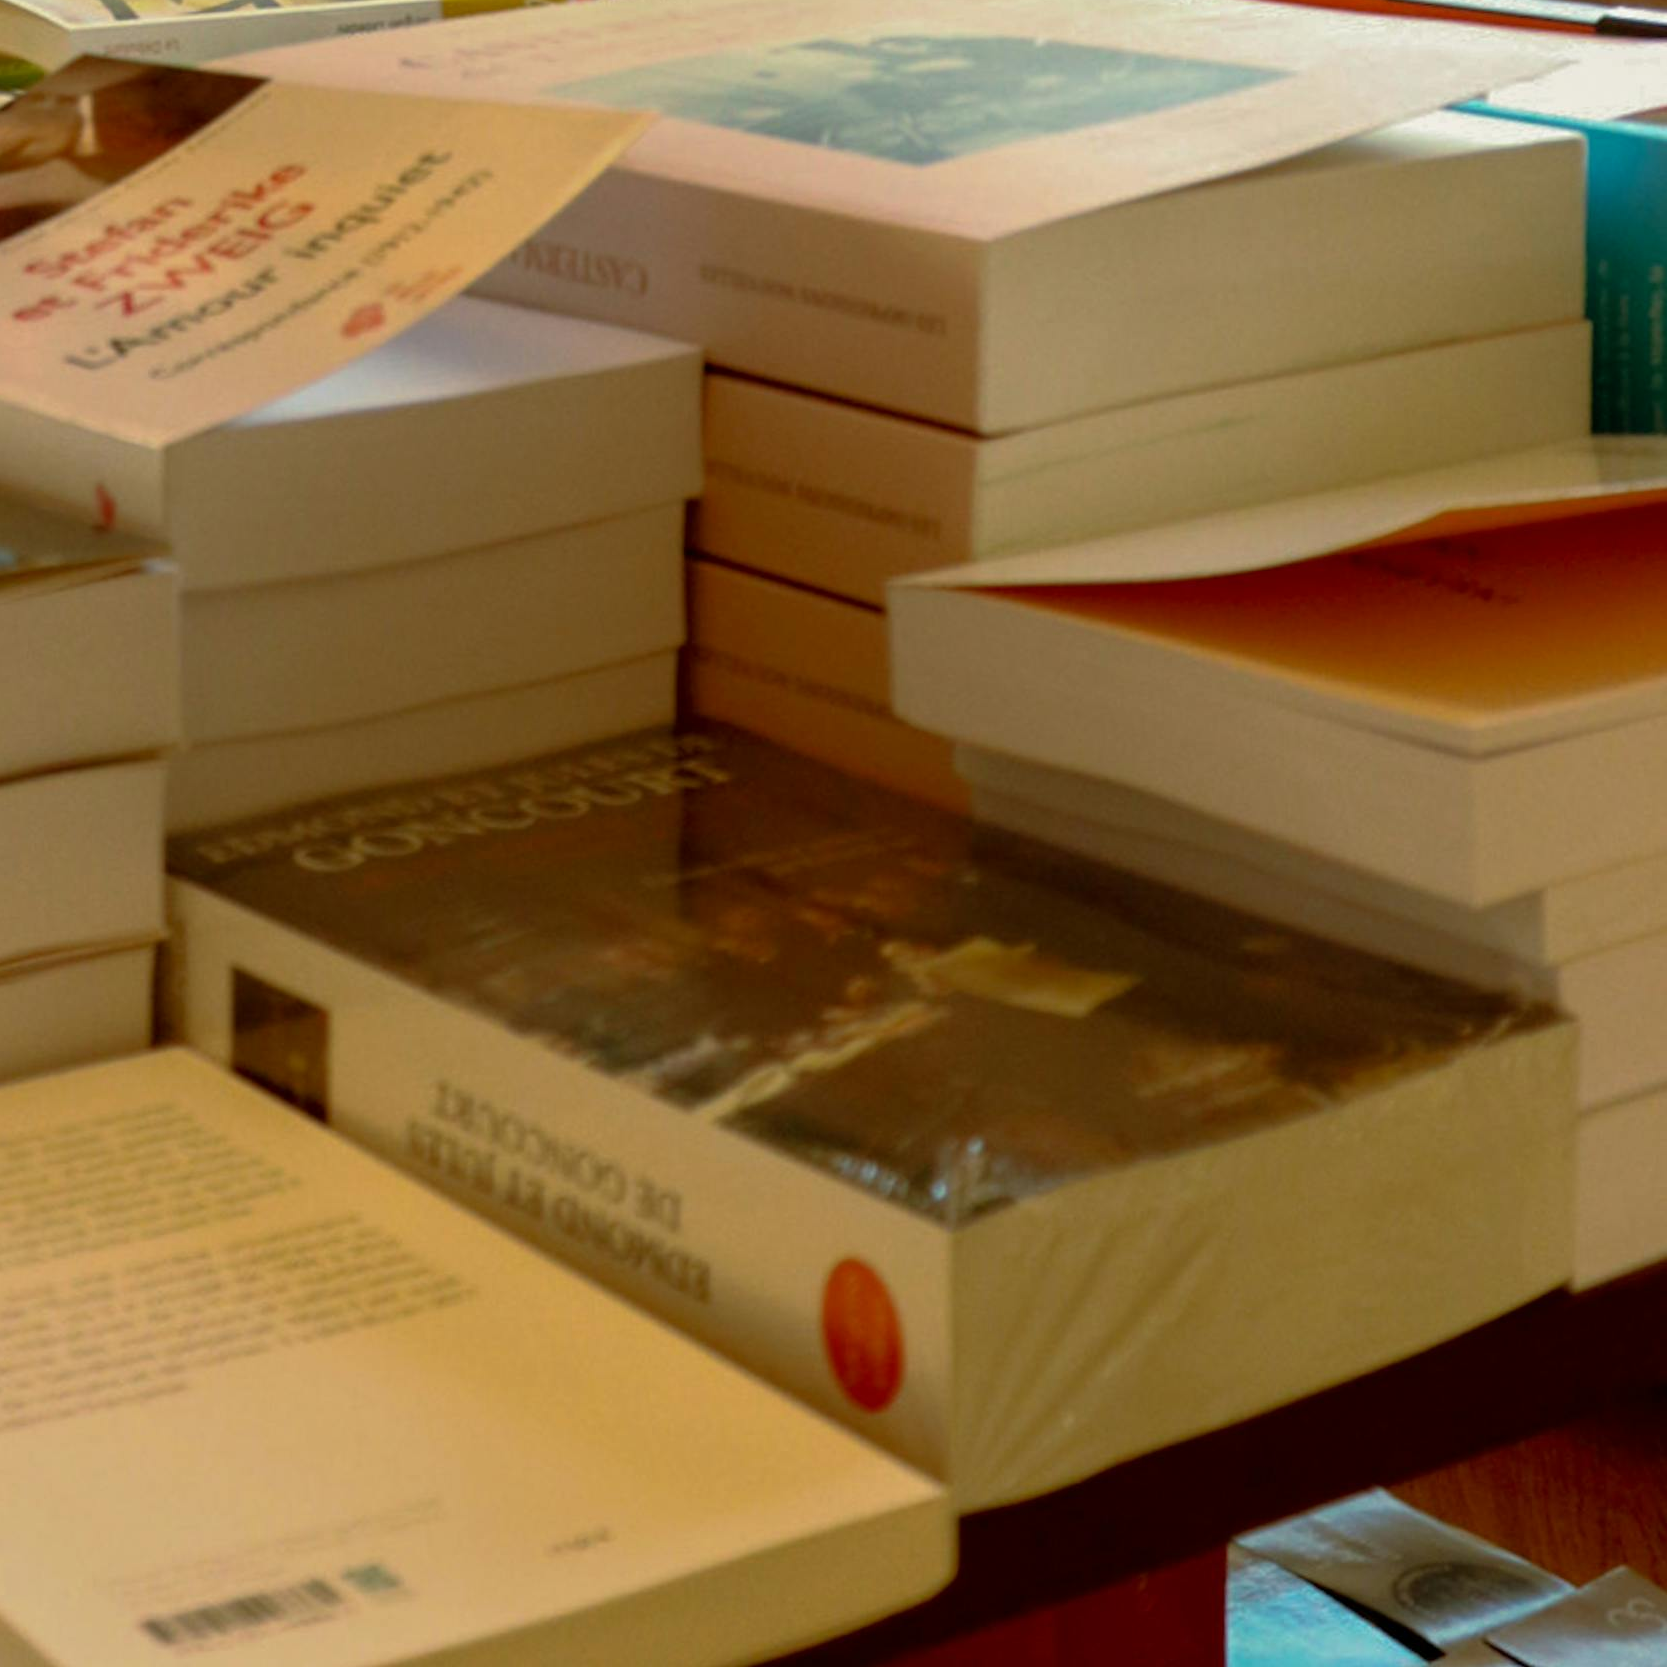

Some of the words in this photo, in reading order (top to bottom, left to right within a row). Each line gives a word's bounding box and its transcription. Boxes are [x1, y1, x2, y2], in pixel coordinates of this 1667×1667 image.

[11, 293, 76, 323] et
[70, 163, 308, 291] Friderike
[22, 194, 194, 280] Stefan
[63, 266, 281, 370] L'Amour
[284, 149, 455, 261] inquiet
[94, 197, 316, 319] ZWEIG
[432, 1078, 629, 1206] GONCOURT
